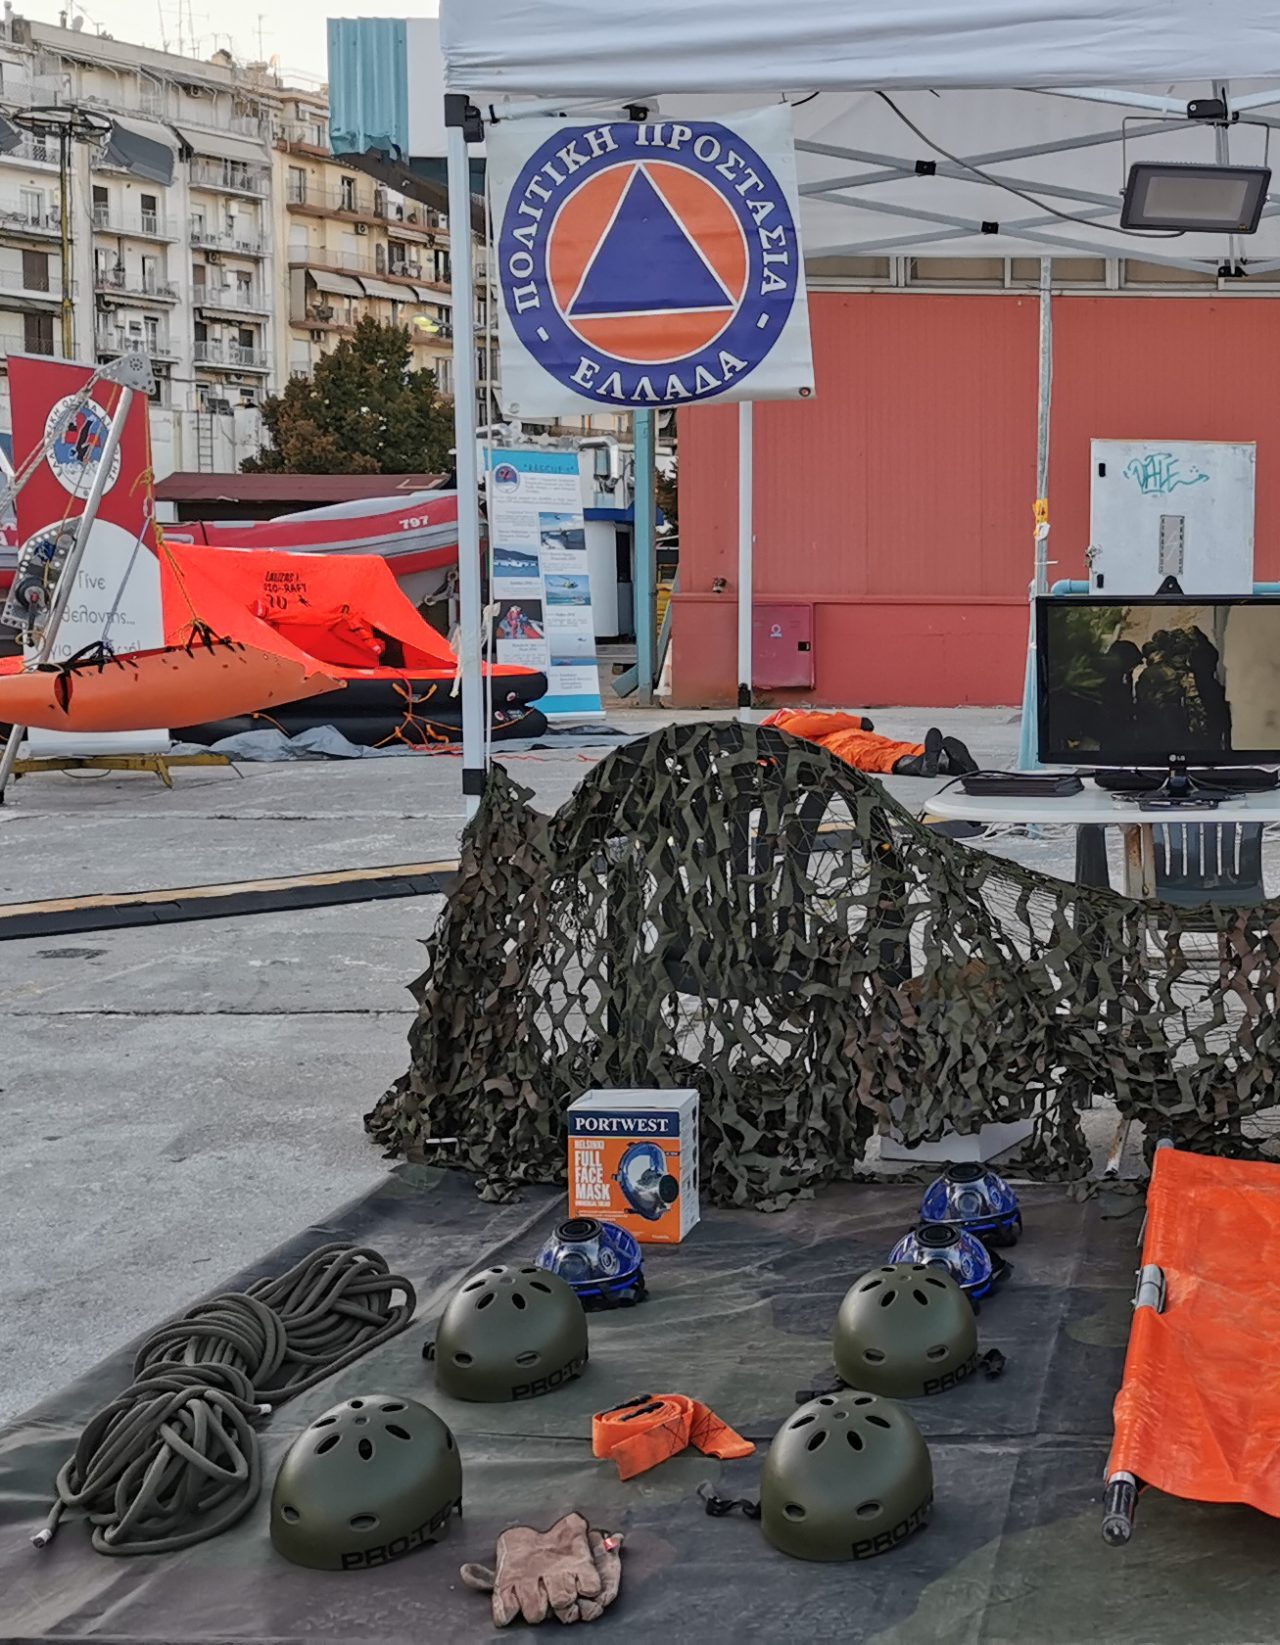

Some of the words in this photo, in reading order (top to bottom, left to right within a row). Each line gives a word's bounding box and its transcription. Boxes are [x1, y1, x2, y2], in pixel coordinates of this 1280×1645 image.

[508, 125, 619, 314] ΠΟΛΙΤΙΚΗ
[634, 123, 789, 295] ΠΡΟΣΤΑΣΙΑ
[569, 350, 748, 401] ΕΛΛΑΔΑ
[399, 515, 430, 530] 797
[575, 1117, 669, 1132] PORTWEST
[575, 1150, 602, 1167] FULL
[575, 1167, 604, 1184] FACE
[575, 1184, 611, 1201] MASK
